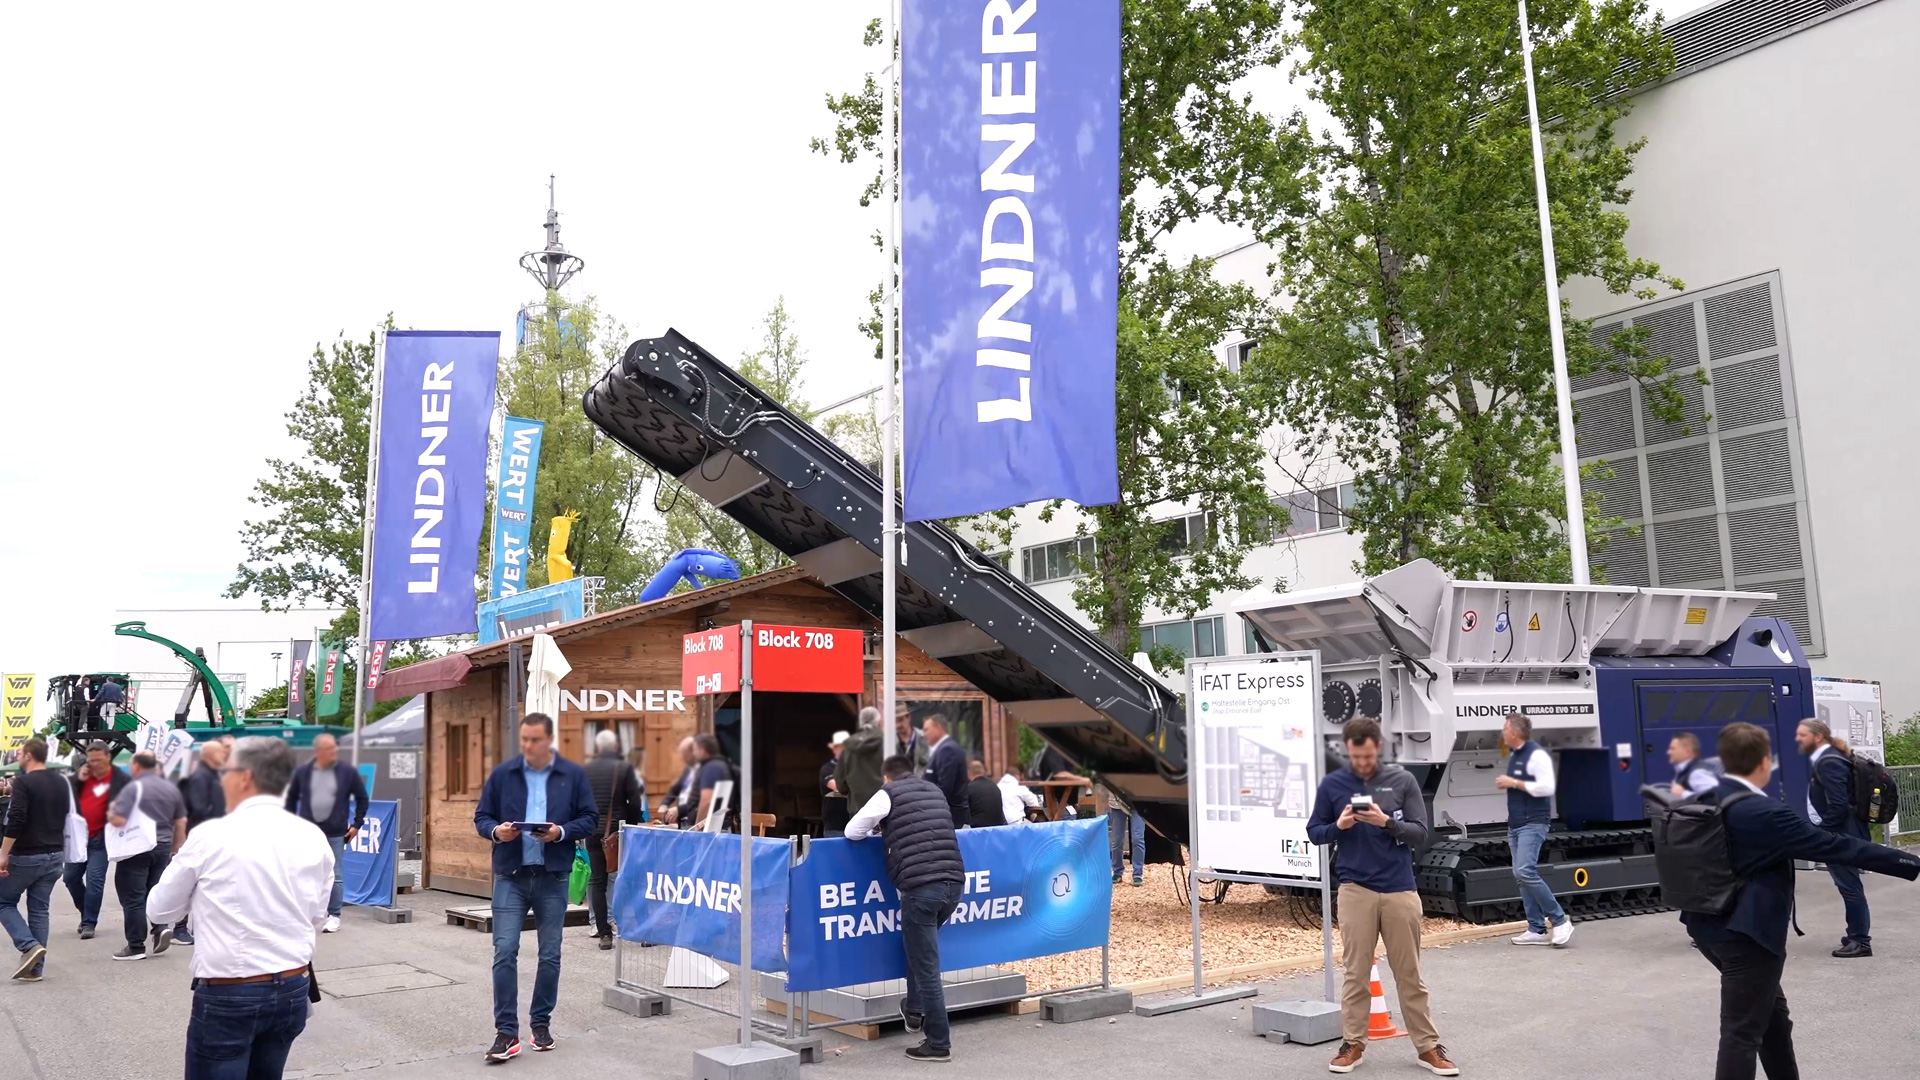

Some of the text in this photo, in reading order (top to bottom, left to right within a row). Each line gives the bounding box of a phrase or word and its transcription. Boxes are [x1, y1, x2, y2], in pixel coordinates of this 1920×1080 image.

[976, 0, 1037, 423] LINDNER
[408, 361, 454, 593] LINDNER
[503, 427, 540, 505] WERT
[501, 507, 526, 521] WERT
[684, 634, 724, 654] Block 708
[758, 629, 834, 649] Block 708
[324, 652, 338, 692] JENZ
[369, 642, 385, 687] JENZ
[291, 661, 301, 701] JENZ
[1200, 673, 1305, 693] IFAT Express
[560, 689, 686, 712] NDNER
[1456, 705, 1518, 717] LINDNER
[1526, 706, 1554, 714] URRACO
[1555, 706, 1569, 714] EVO
[1580, 705, 1589, 713] DT
[1281, 839, 1310, 855] IFAT
[1287, 858, 1312, 868] Munich
[645, 872, 741, 914] LINDNER
[820, 882, 857, 909] BE
[863, 880, 886, 904] A
